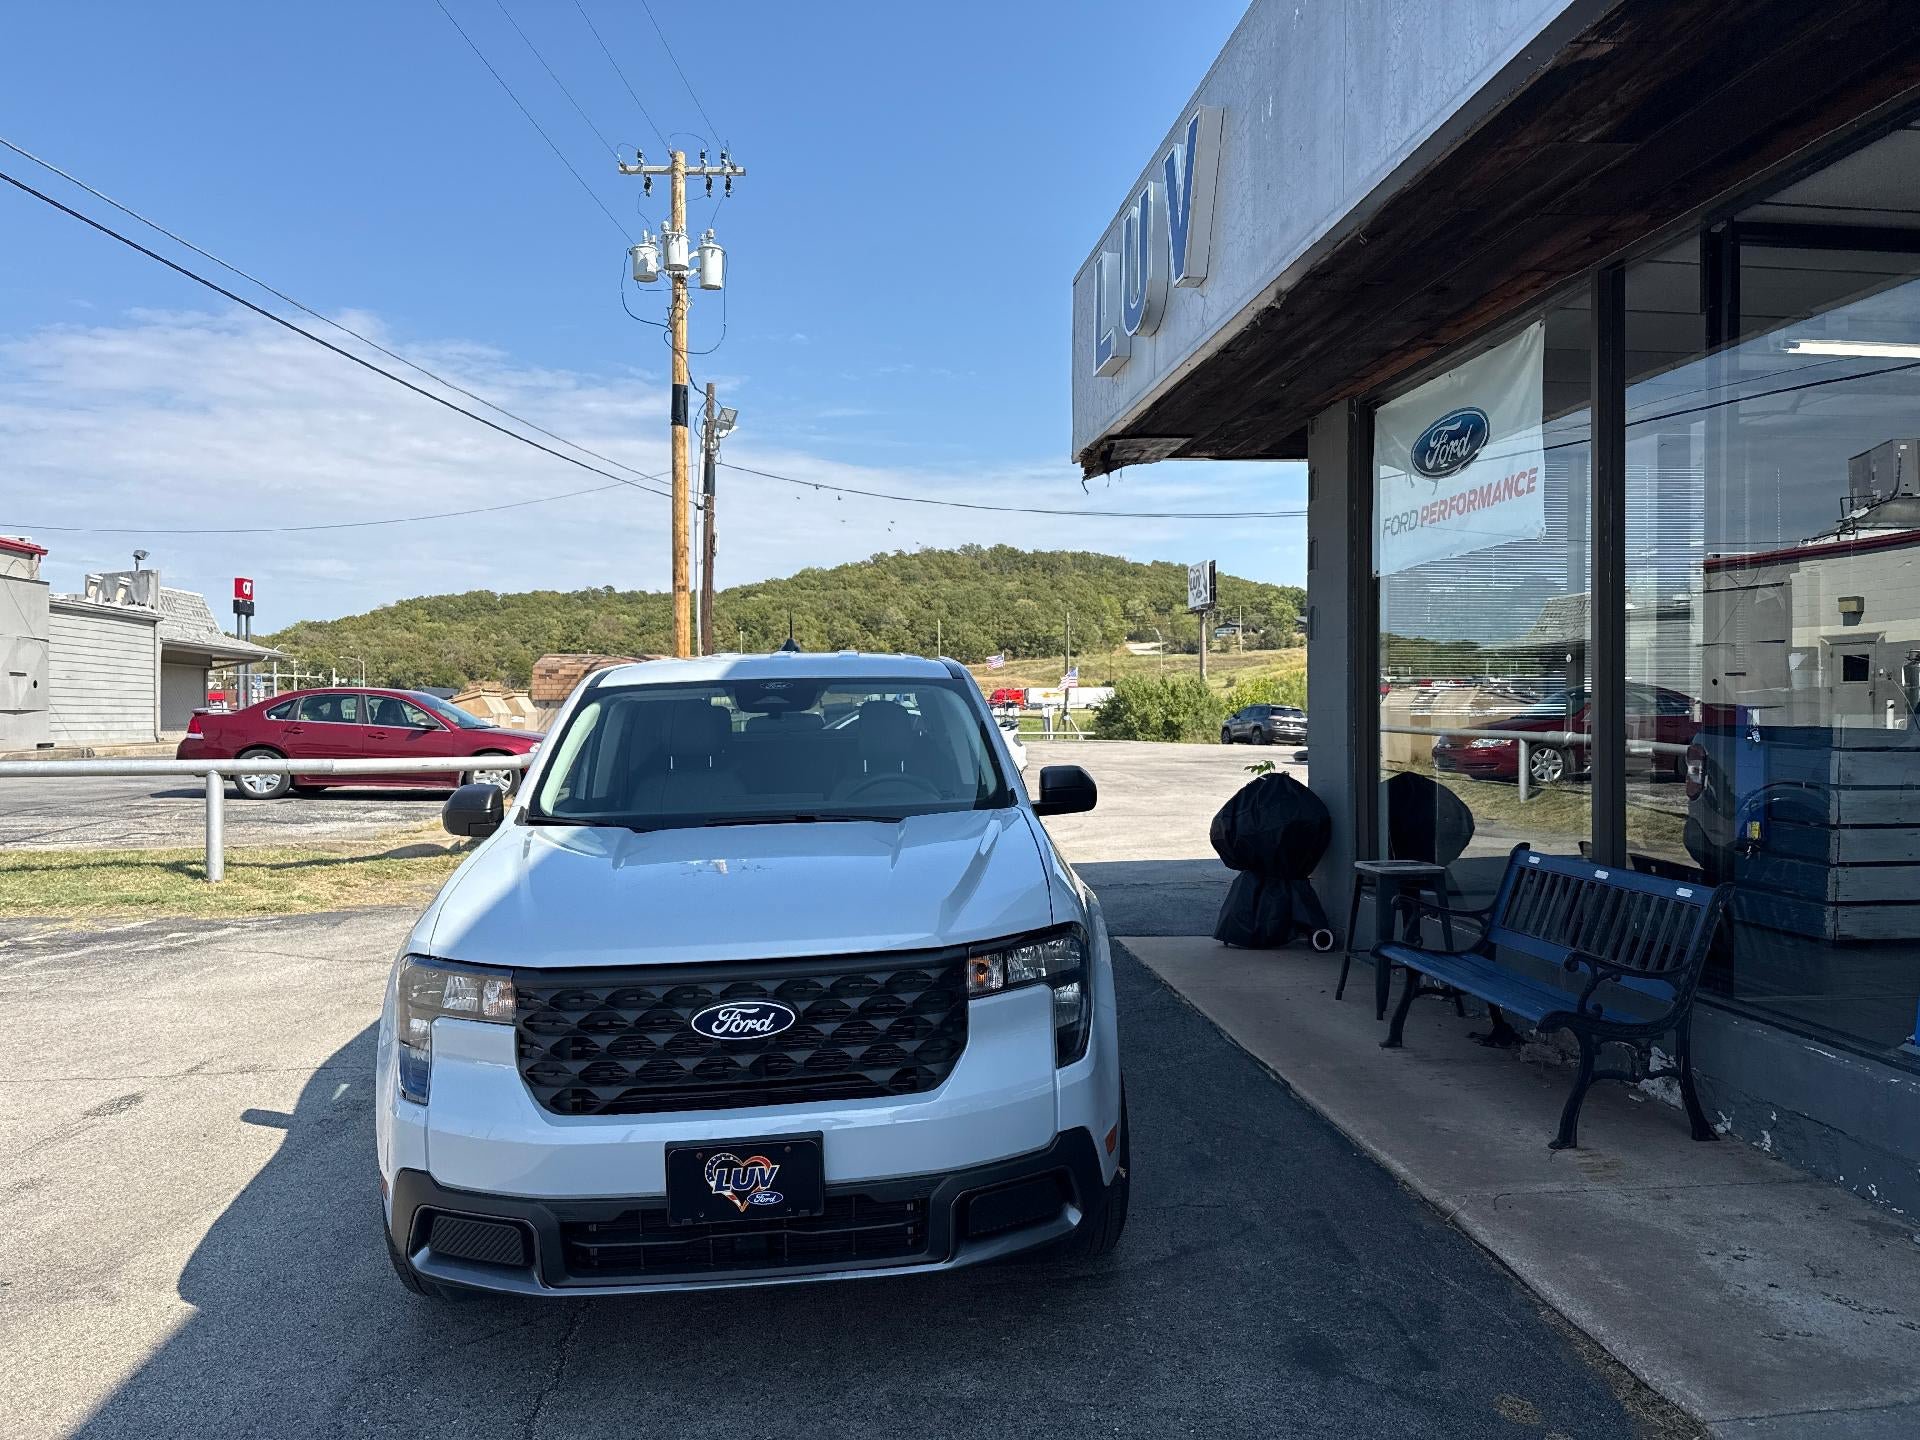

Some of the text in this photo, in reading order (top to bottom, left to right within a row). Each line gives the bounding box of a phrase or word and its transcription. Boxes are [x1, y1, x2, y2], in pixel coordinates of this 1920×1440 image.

[1094, 105, 1210, 377] LUV
[1425, 420, 1474, 470] Ford
[1382, 467, 1539, 539] FORD PERFORMANCE
[711, 1007, 775, 1034] Ford
[712, 1164, 780, 1194] LUV
[753, 1193, 776, 1204] Ford
